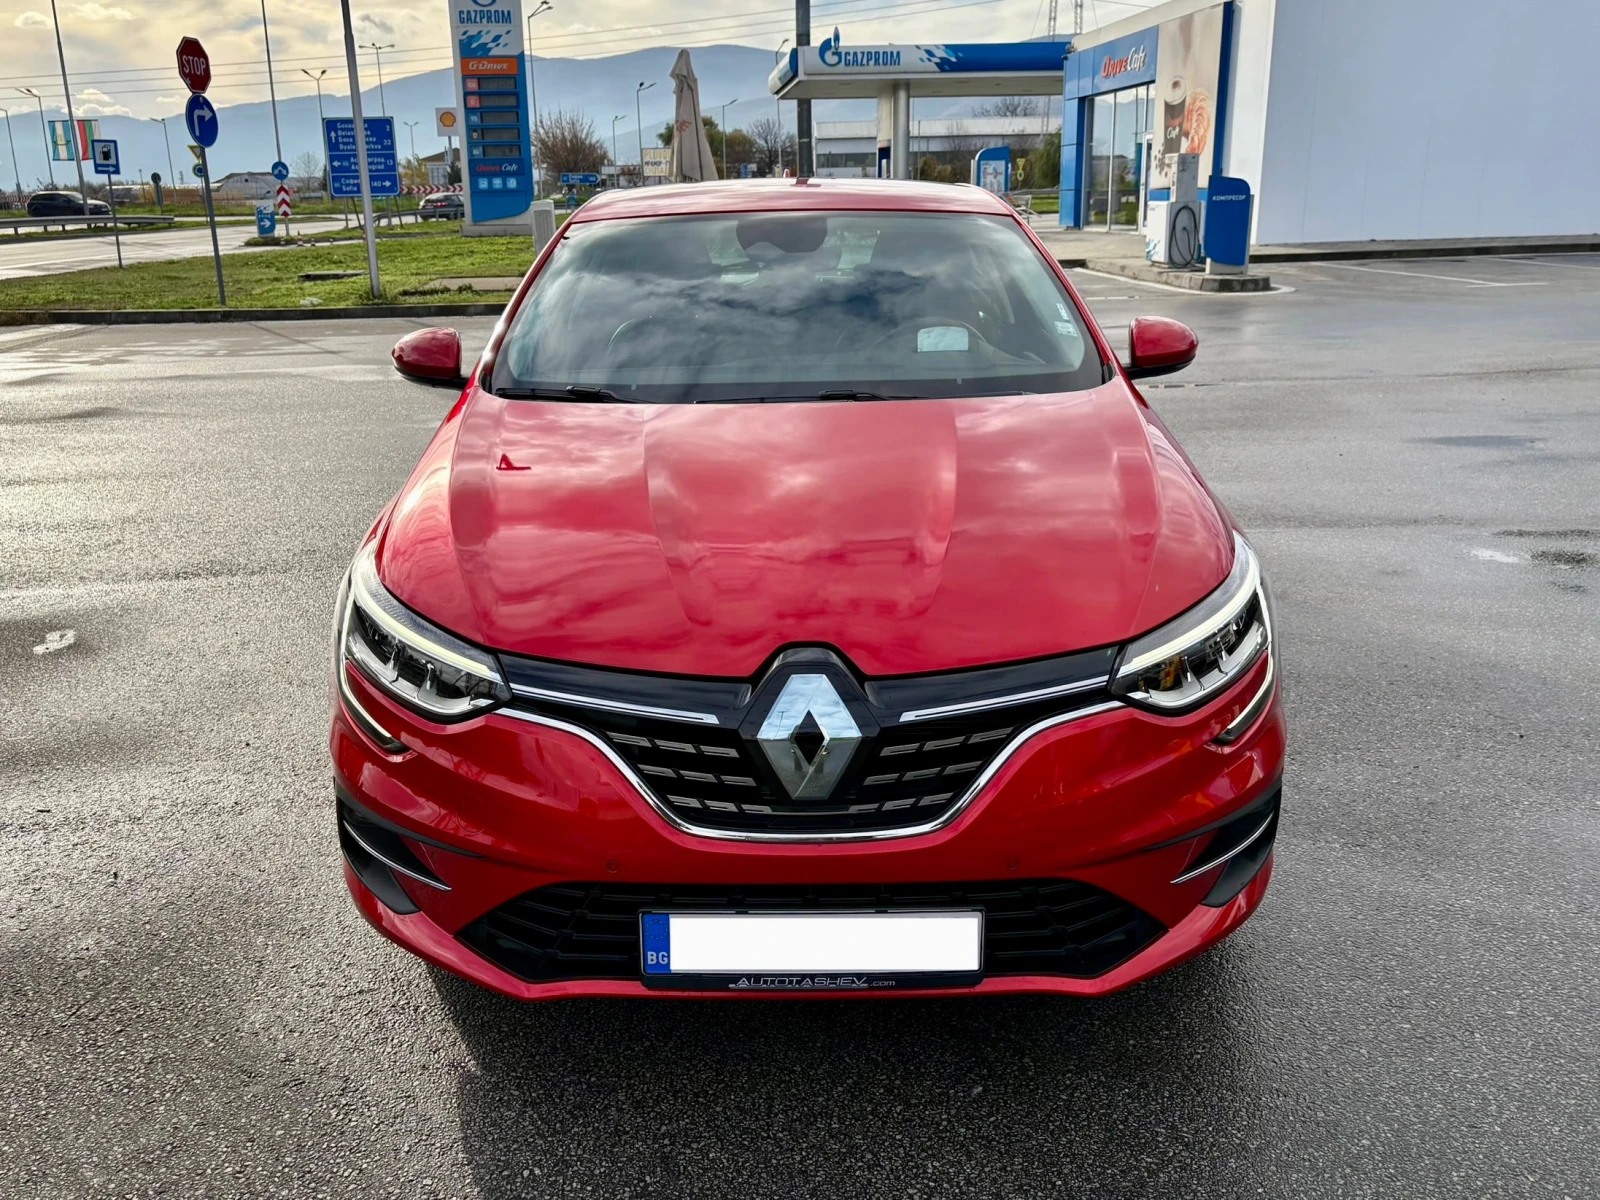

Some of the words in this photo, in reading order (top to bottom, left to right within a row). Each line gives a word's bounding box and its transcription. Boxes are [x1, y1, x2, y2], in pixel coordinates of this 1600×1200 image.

[458, 9, 512, 25] GAZPROM
[182, 55, 206, 76] STOP
[843, 50, 901, 67] GAZPROM
[1212, 194, 1247, 202] КОМПРЕСОР
[647, 951, 669, 965] BG
